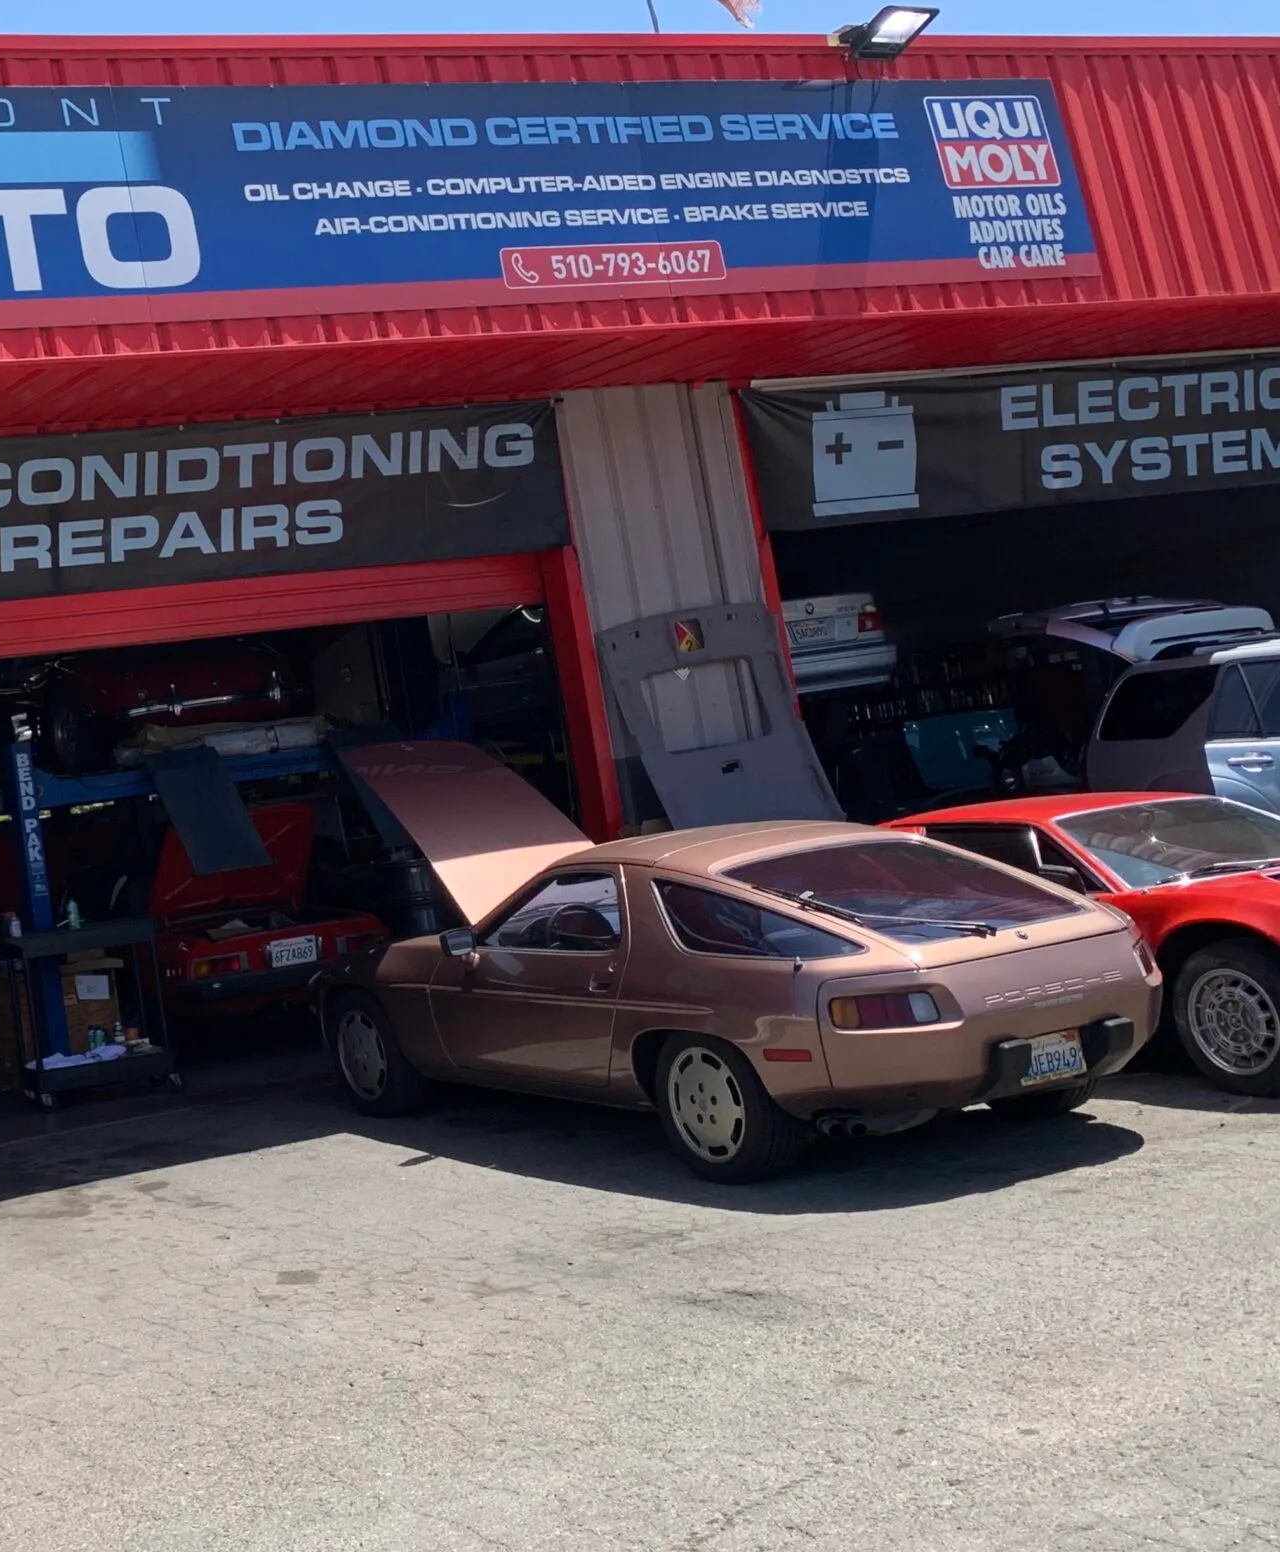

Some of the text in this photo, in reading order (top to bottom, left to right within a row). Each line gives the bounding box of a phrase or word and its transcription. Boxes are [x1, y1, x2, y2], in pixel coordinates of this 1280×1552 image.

[232, 112, 900, 152] DIAMOND CERTIFIED SERVICE
[932, 101, 1042, 140] LIQUI
[944, 144, 1049, 182] MOLY
[244, 167, 910, 202] OIL CHANGE COMPUTER-AIDED ENGINE DIAGNOSTICS
[314, 200, 869, 236] AIR-CONDITIONING SERVICE BRAKE SERVICE
[952, 193, 1067, 218] MOTOR OILS
[969, 218, 1064, 244] ADDITIVES
[551, 249, 711, 279] 510-793-6067
[978, 244, 1066, 269] CAR CARE
[0, 499, 343, 573] REPAIRS
[15, 753, 36, 811] BEND
[24, 818, 44, 862] PAK
[983, 969, 1124, 1007] PORSCHE
